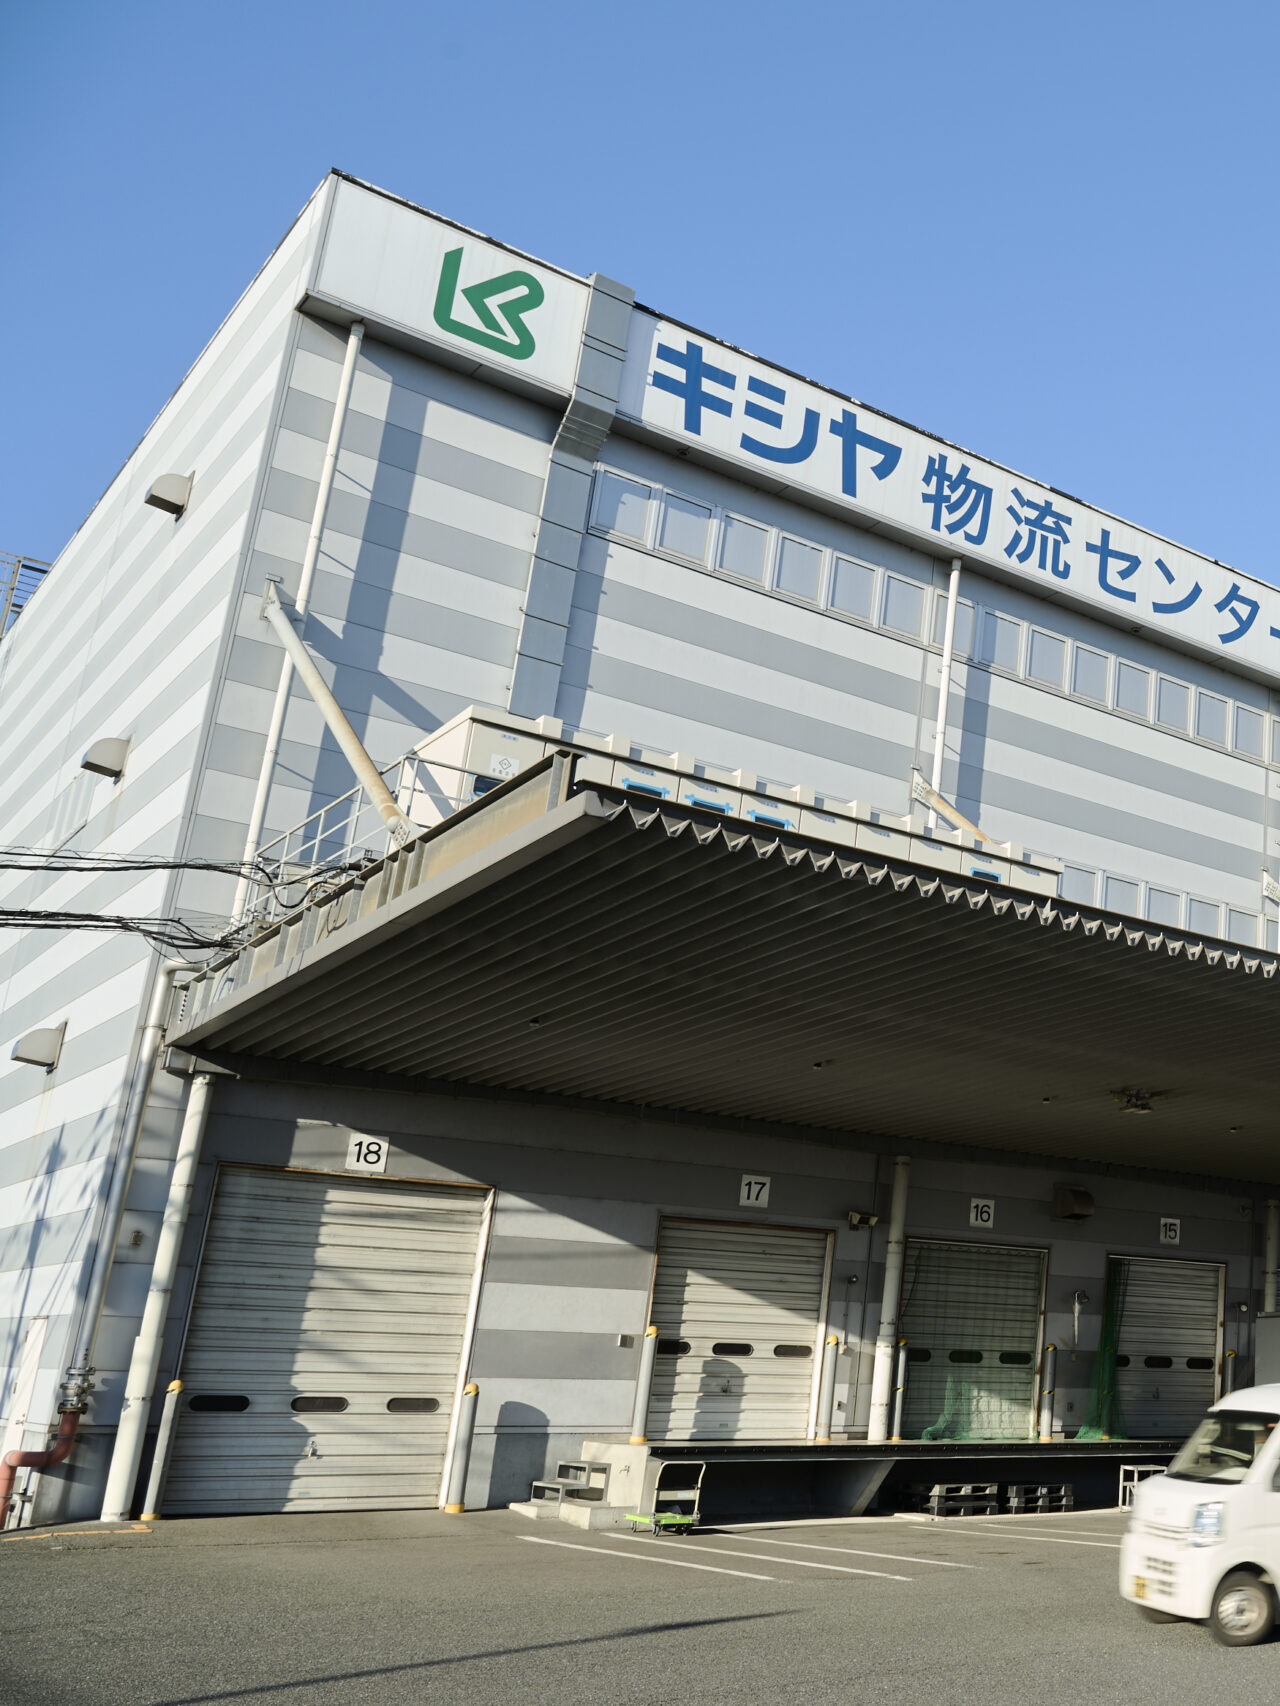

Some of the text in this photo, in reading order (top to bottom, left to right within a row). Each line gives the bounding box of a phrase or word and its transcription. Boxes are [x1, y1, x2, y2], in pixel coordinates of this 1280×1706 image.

[353, 1140, 382, 1165] 18
[744, 1180, 767, 1202] 17
[973, 1203, 991, 1223] 16
[1162, 1221, 1178, 1240] 15
